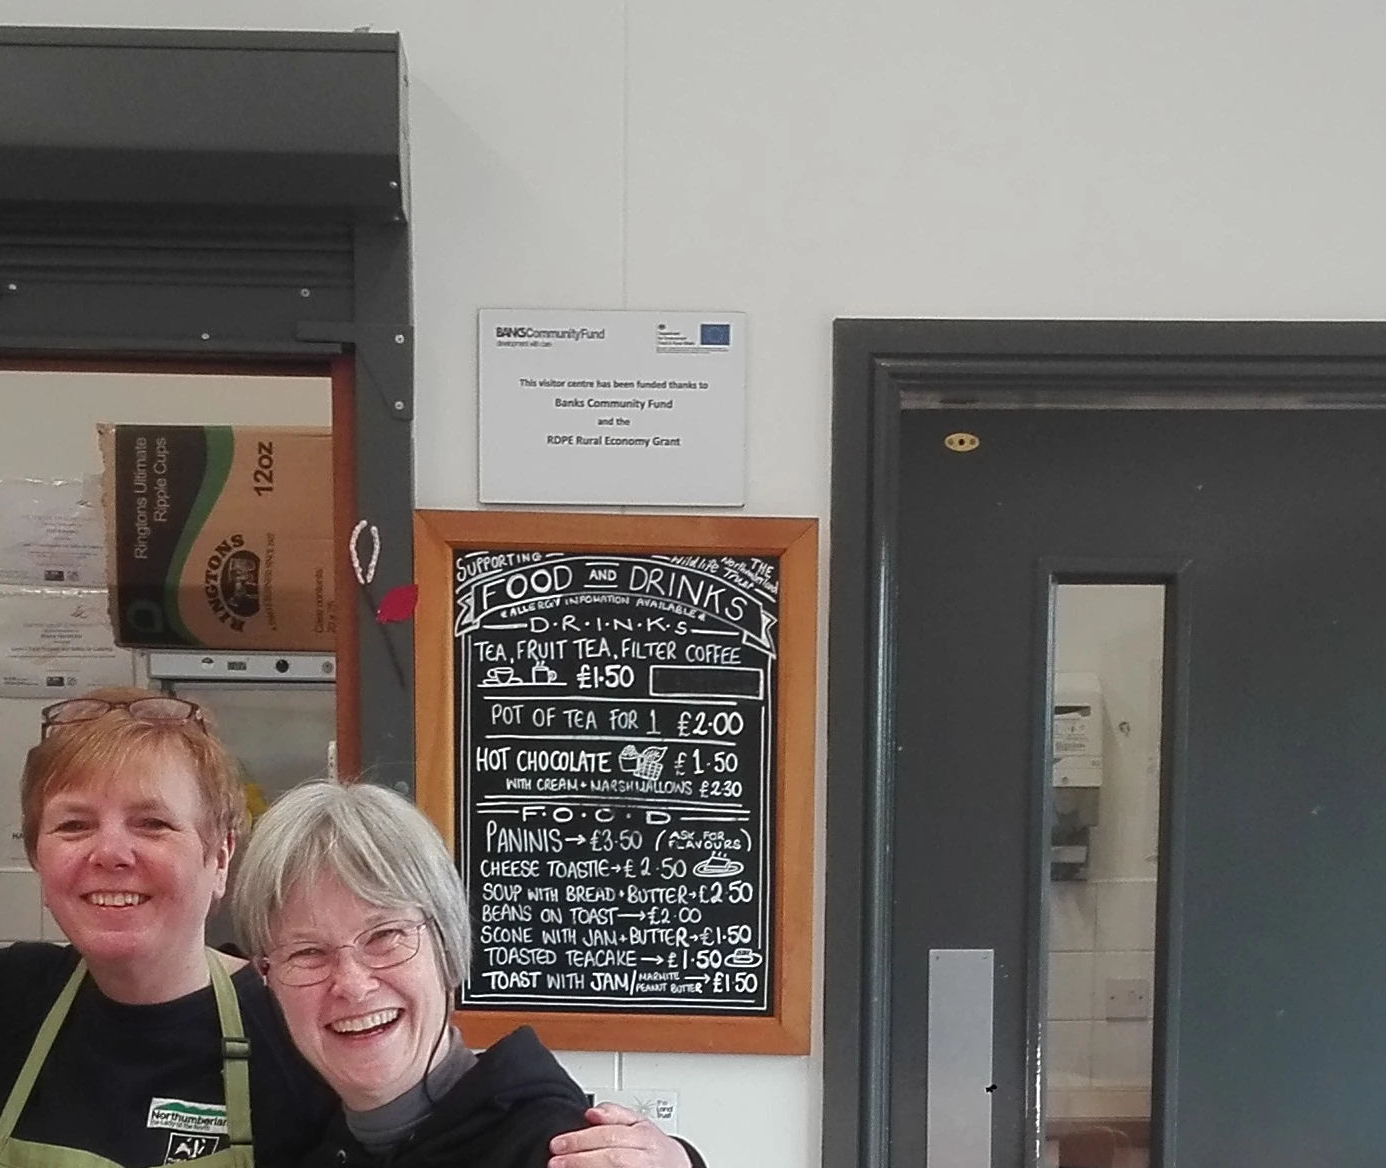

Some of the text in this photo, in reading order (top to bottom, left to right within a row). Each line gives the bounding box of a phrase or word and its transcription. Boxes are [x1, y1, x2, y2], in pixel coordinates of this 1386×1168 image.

[520, 379, 709, 390] This visitor centre has been funded thanks to
[555, 399, 673, 410] Banks Community Fund
[597, 418, 631, 427] and the
[547, 436, 681, 448] RDPE Rural Economy Grant
[154, 437, 170, 522] Ripple Cups
[254, 440, 273, 497] 12oz
[134, 437, 151, 559] Ringtons Ultimate
[456, 552, 543, 582] SUPPORTING
[750, 557, 774, 579] THE
[205, 533, 245, 633] RINGTONS
[482, 565, 749, 622] FOOD AND DRINKS
[517, 639, 568, 661] FRUIT
[622, 638, 677, 660] FILTER
[685, 643, 742, 665] COFFEE
[492, 704, 523, 727] POT
[533, 707, 555, 727] OF
[563, 708, 598, 730] TEA
[610, 708, 640, 731] FOR
[476, 747, 511, 773] HOT
[516, 750, 612, 775] CHOCOLATE
[506, 777, 532, 792] WITH
[536, 777, 579, 793] CREAM
[589, 778, 693, 797] MARSHMALLOWS
[486, 820, 564, 854] PANINIS
[703, 831, 726, 842] FOR
[480, 860, 541, 878] CHEESE
[546, 860, 611, 879] TOASTIE
[482, 884, 523, 902] SOUP
[527, 887, 559, 902] WITH
[566, 886, 616, 904] BREAD
[628, 886, 689, 904] BUTTER
[482, 907, 532, 923] BEANS
[541, 908, 563, 925] ON
[570, 908, 619, 925] TOAST
[480, 926, 533, 944] SCONE
[542, 928, 577, 945] WITH
[582, 929, 618, 947] JAM
[629, 930, 689, 948] BUTTER
[485, 946, 557, 967] TOASTED
[566, 949, 637, 968] TEACAKE
[482, 971, 542, 989] TOAST
[546, 973, 585, 991] WITH
